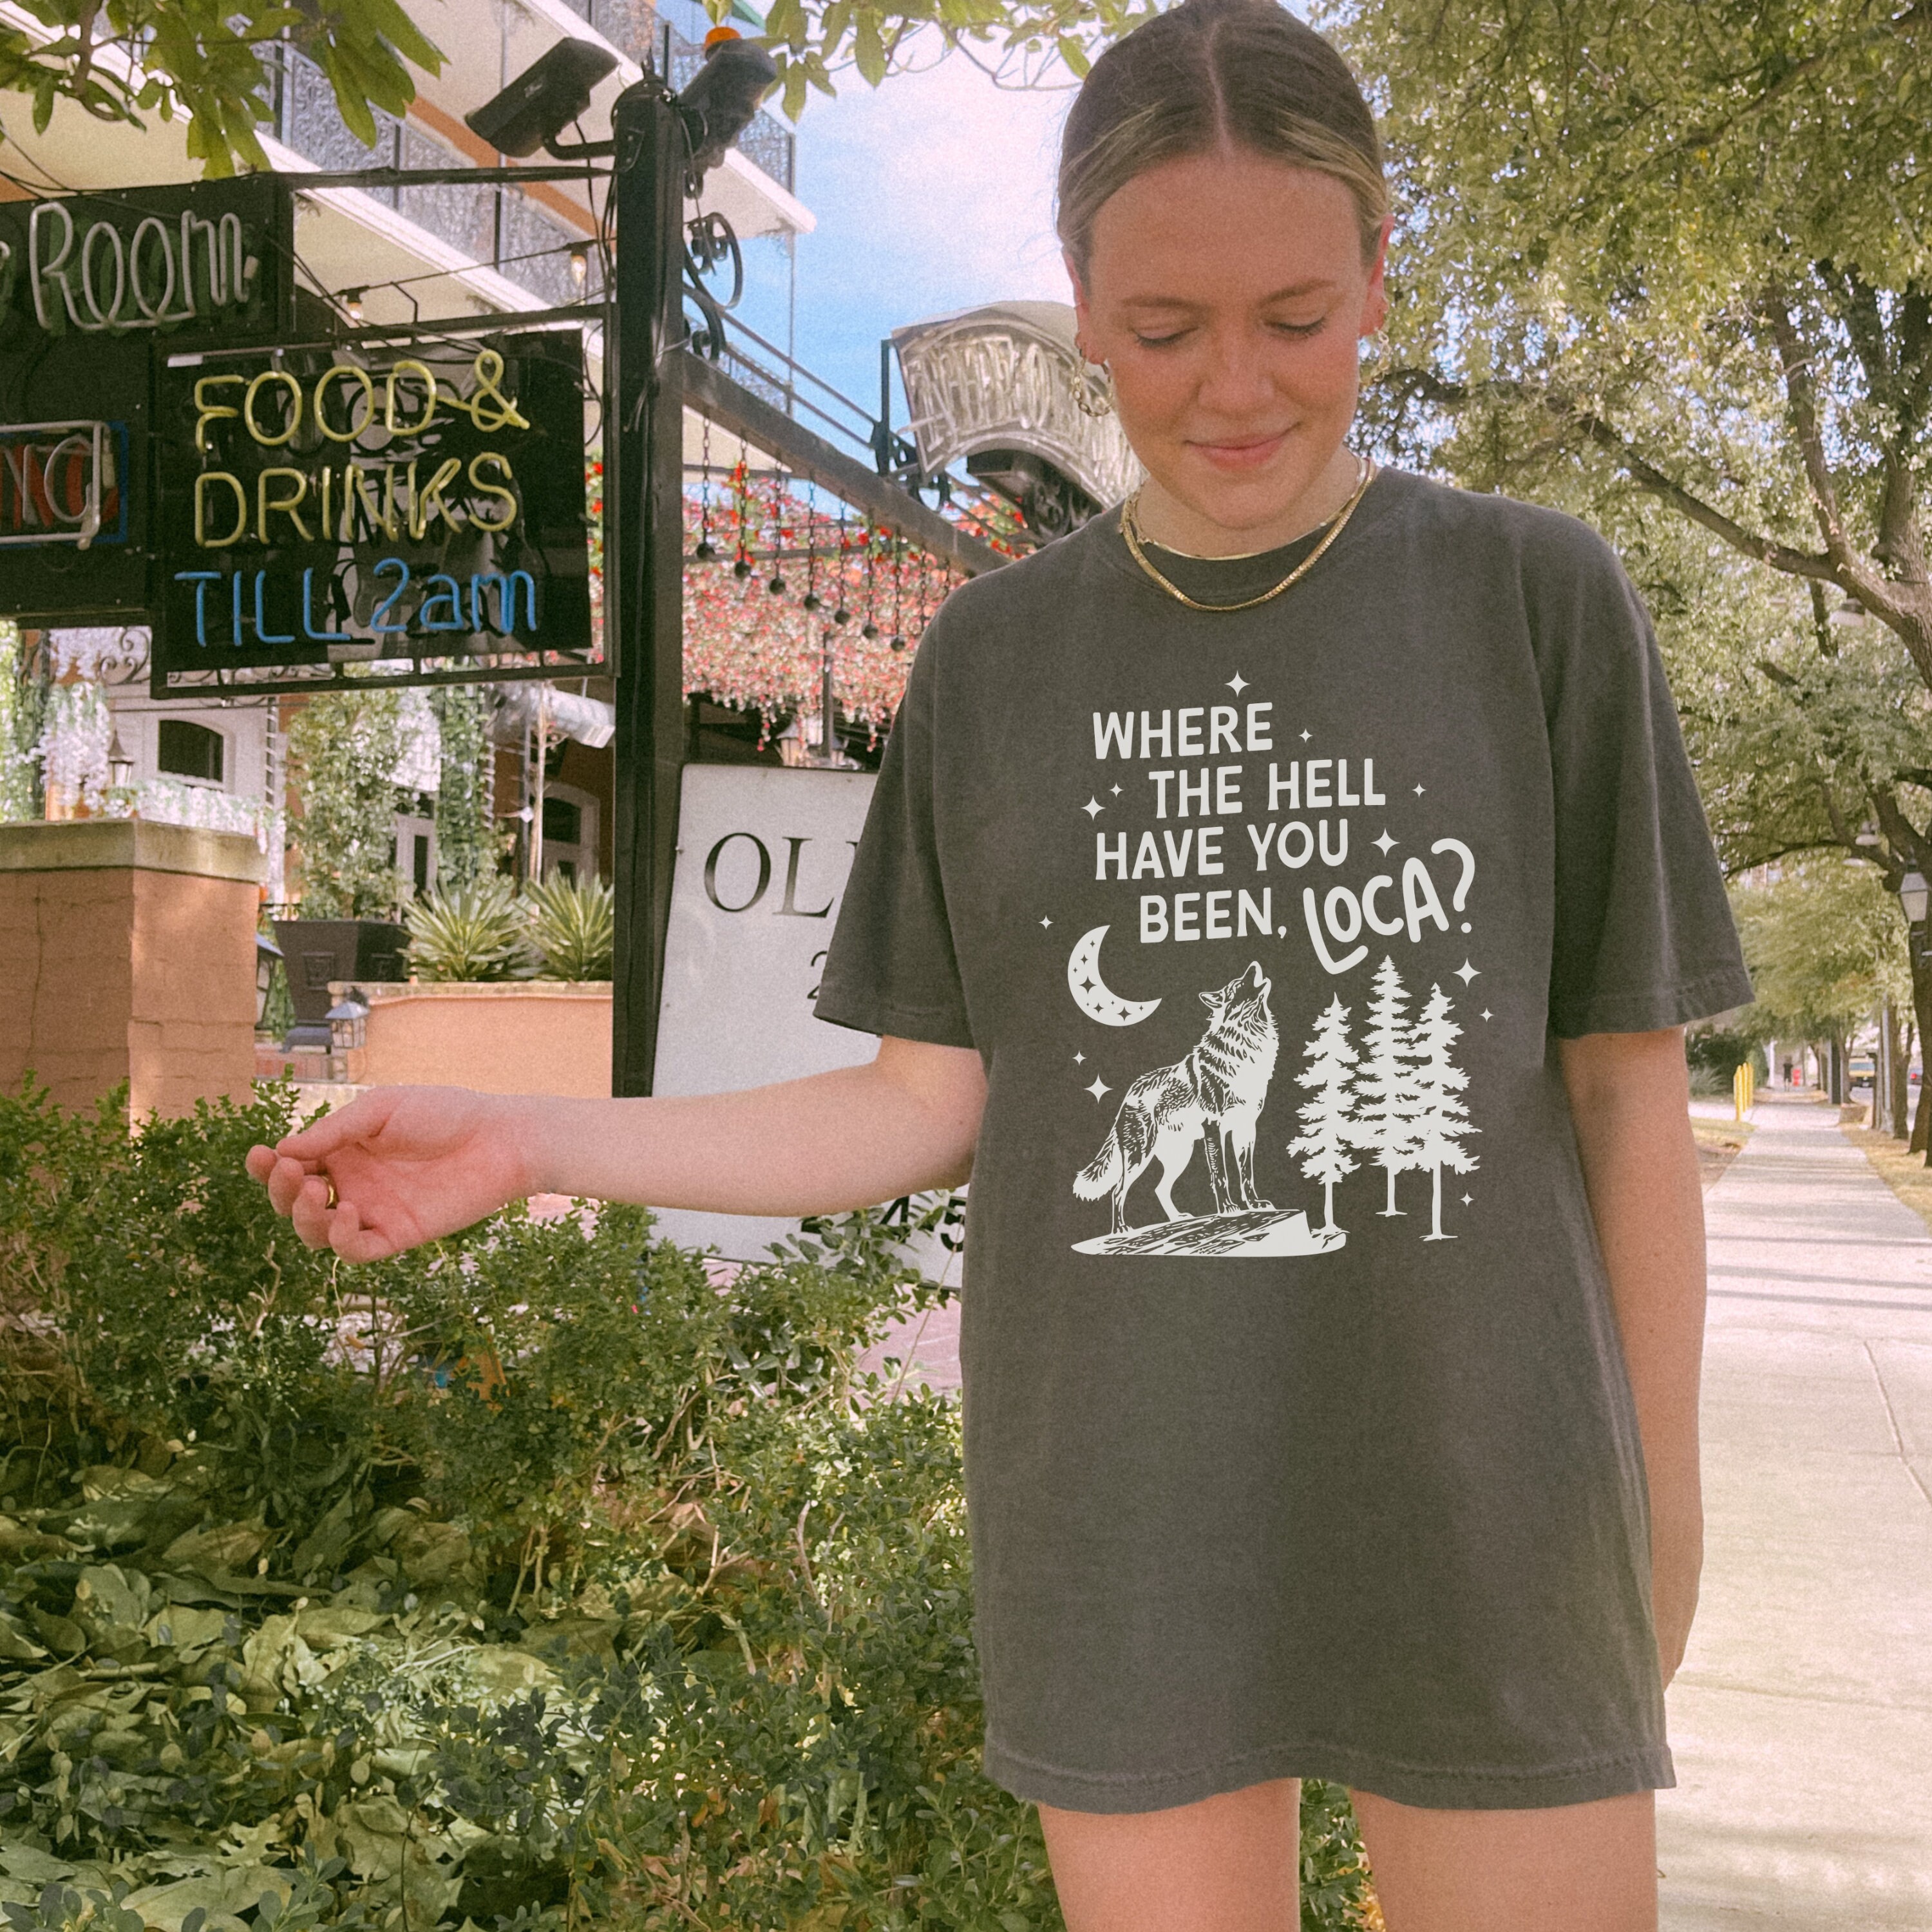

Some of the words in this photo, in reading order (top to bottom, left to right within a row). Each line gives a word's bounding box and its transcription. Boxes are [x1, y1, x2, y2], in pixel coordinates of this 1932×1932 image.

[195, 360, 437, 451] FOOD
[471, 350, 531, 432] &
[195, 452, 517, 548] DRINKS
[175, 567, 351, 647] TILL
[370, 558, 536, 633] 2am
[1092, 701, 1273, 760] WHERE
[1148, 764, 1243, 819] THE
[1267, 758, 1387, 811] HELL
[704, 832, 859, 918] OL
[1095, 826, 1224, 881] HAVE
[1247, 818, 1349, 872] YOU
[1140, 886, 1287, 943] BEEN,
[1303, 838, 1476, 975] LOCA?
